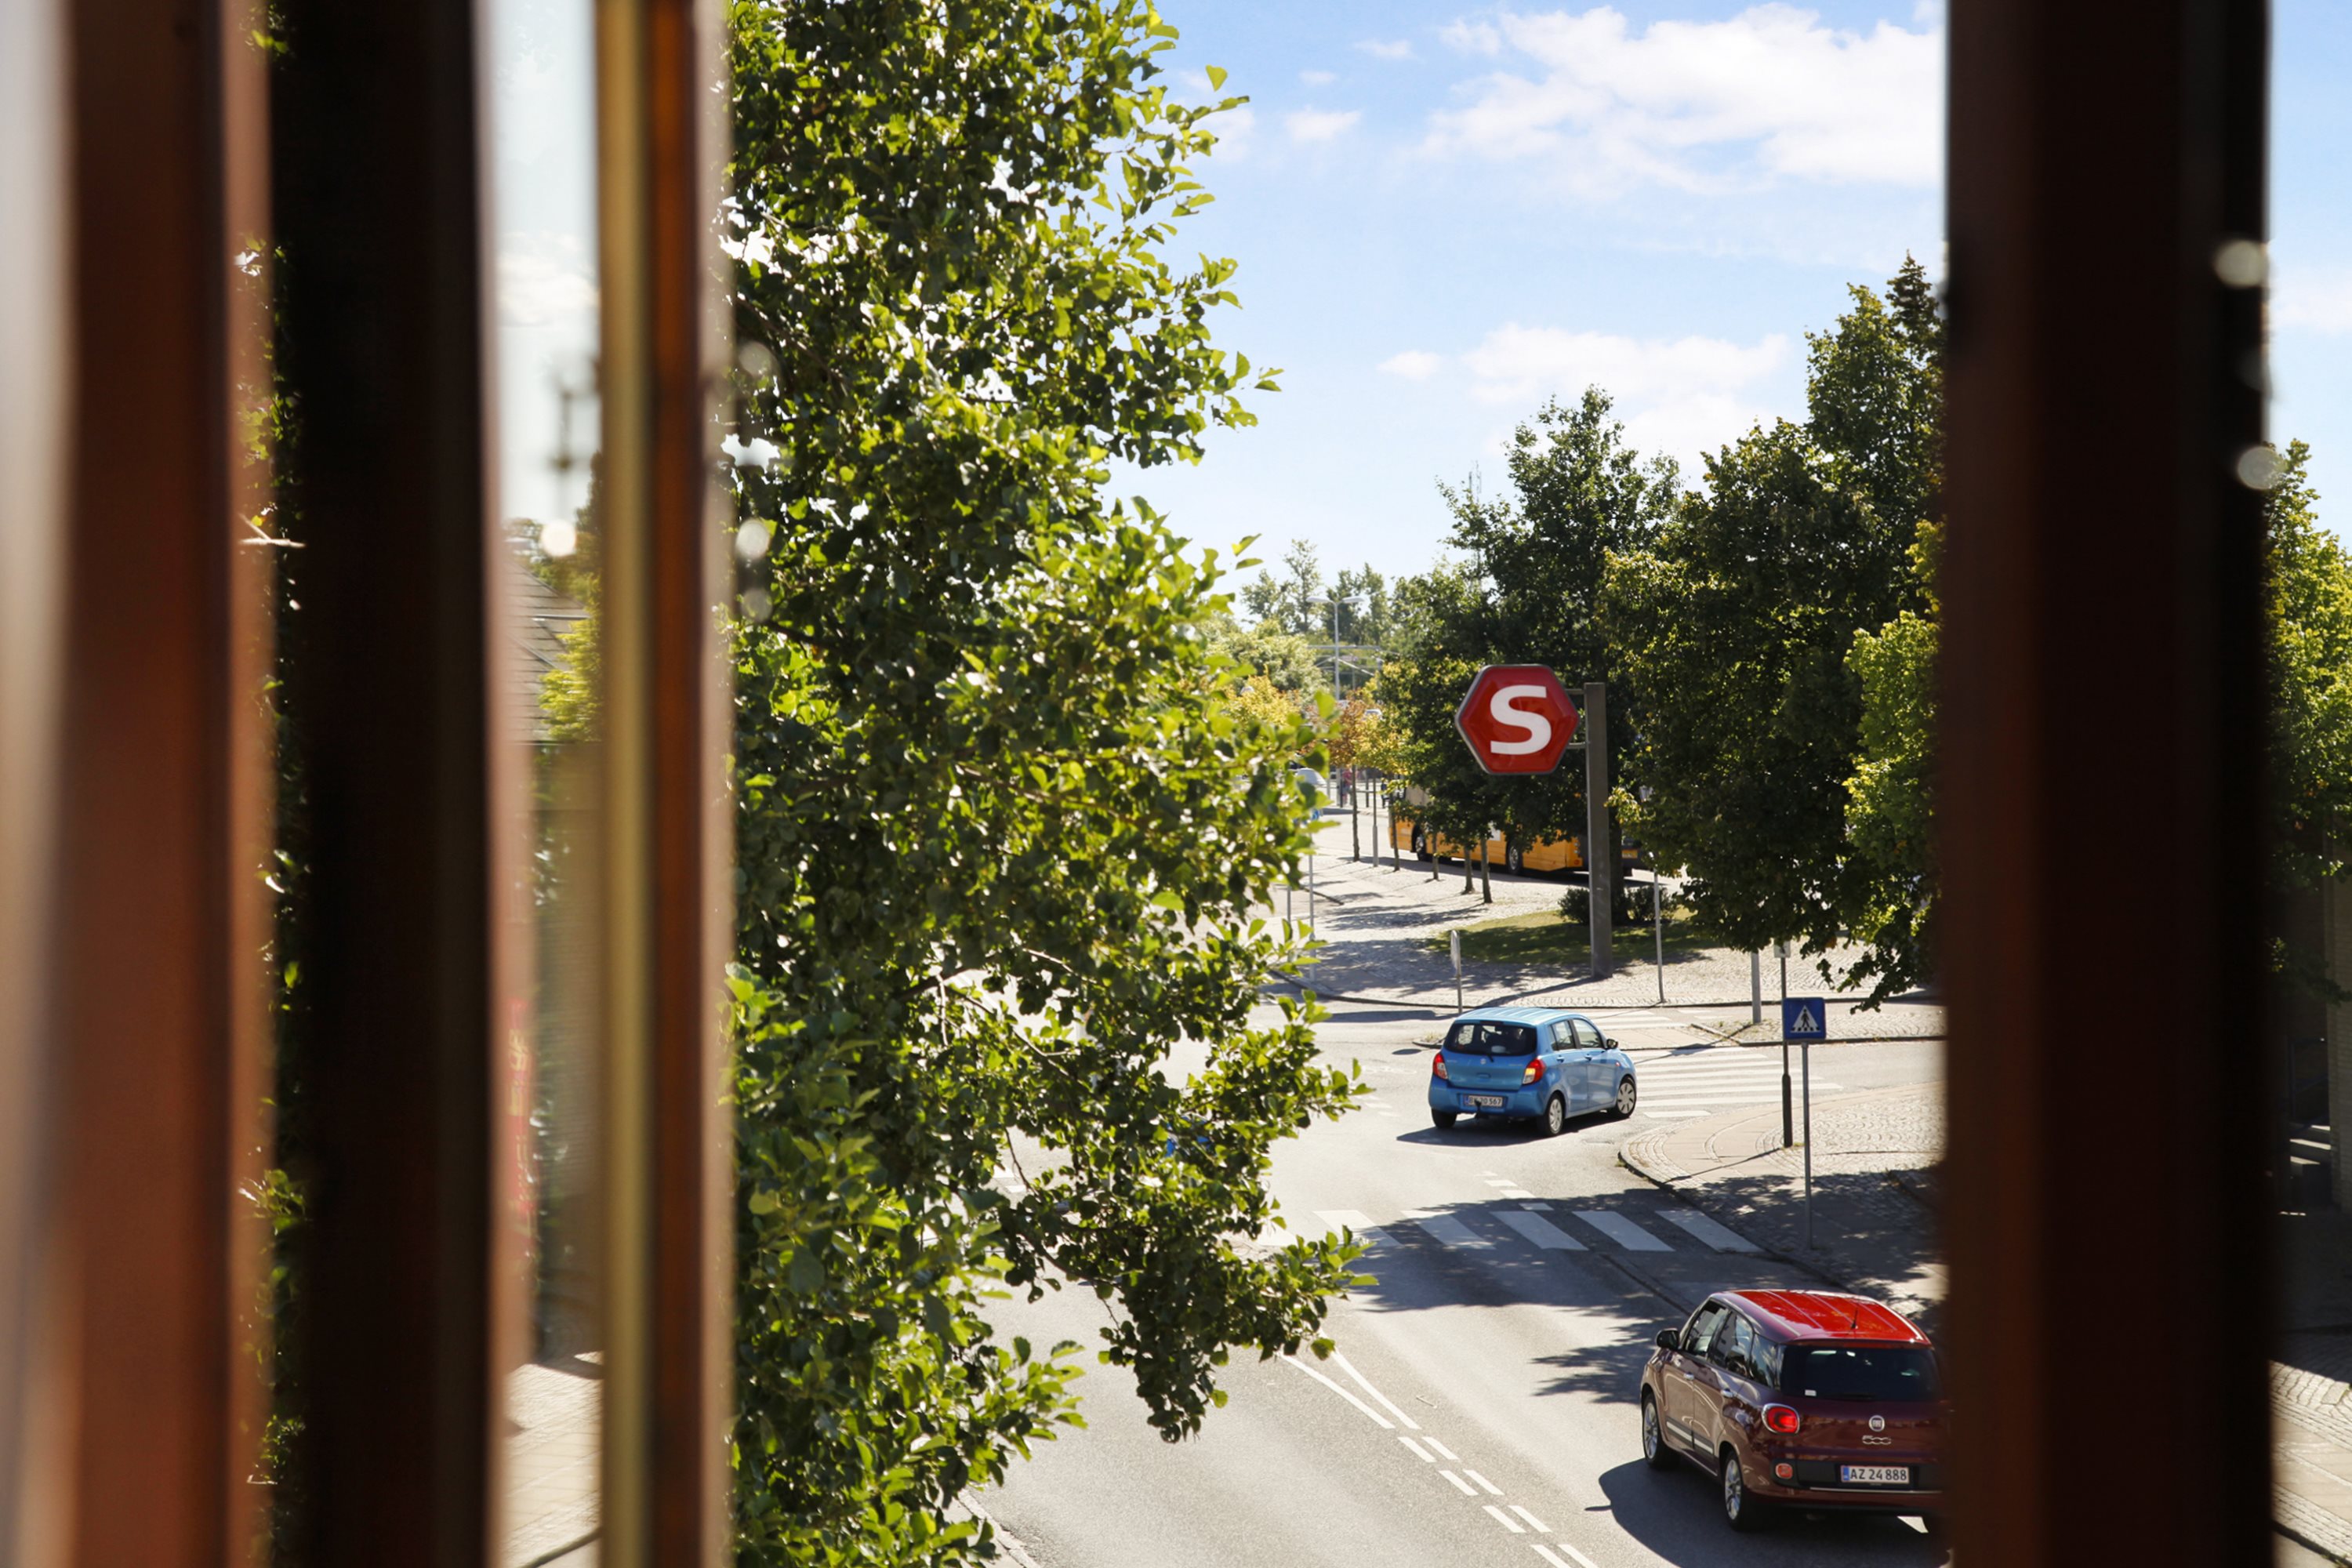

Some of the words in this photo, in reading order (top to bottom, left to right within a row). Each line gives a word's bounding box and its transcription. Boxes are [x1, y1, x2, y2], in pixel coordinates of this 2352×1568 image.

[1490, 684, 1552, 755] S
[1850, 1468, 1866, 1480] AZ
[1868, 1468, 1883, 1480] 24
[1885, 1469, 1907, 1481] 888
